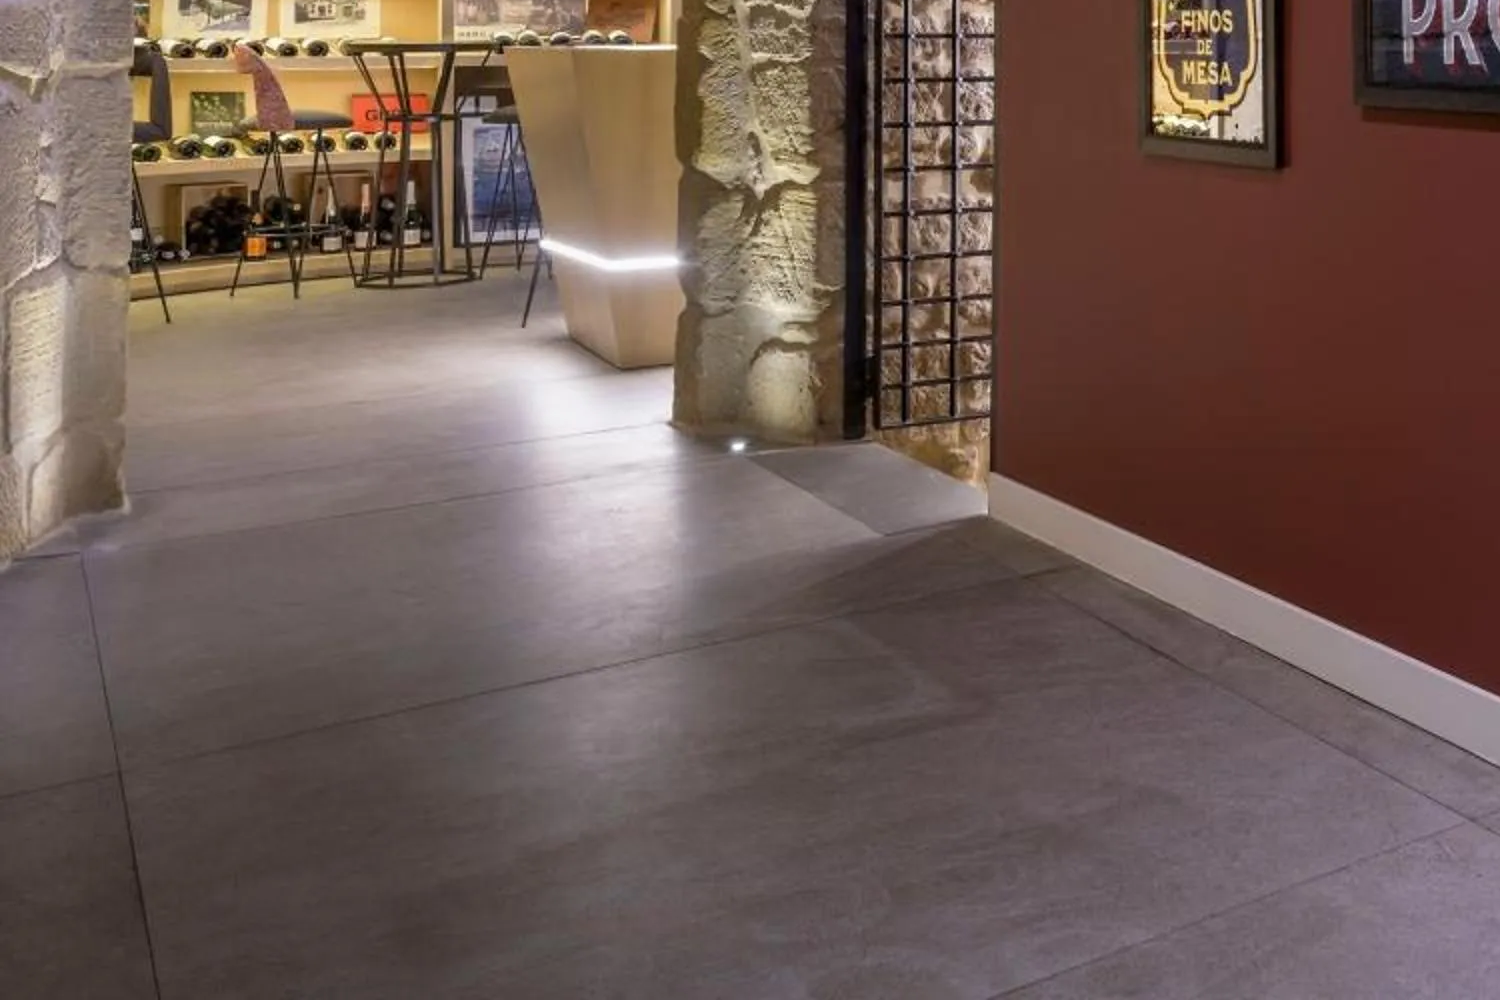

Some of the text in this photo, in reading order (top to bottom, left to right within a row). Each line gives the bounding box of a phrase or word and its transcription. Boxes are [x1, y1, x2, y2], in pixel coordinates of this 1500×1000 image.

[1181, 9, 1234, 34] FINOS
[1196, 39, 1213, 55] DE
[1181, 62, 1233, 86] MESA
